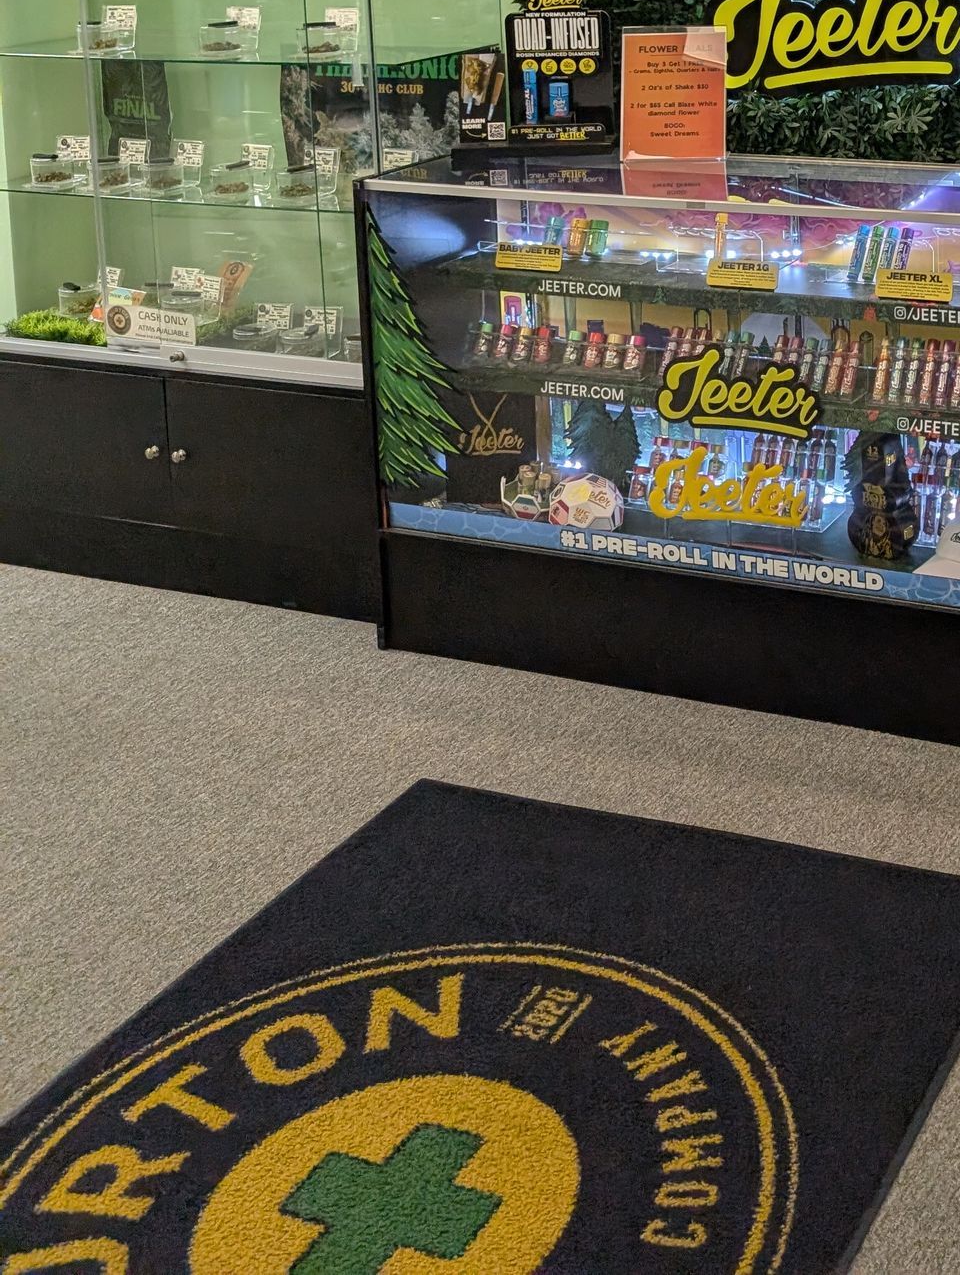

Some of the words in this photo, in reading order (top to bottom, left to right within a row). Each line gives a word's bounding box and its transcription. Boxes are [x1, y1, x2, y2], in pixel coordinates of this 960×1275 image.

[514, 17, 600, 51] QUAD-INFUSED
[397, 84, 424, 94] CLUB
[113, 99, 160, 119] FINAL
[499, 244, 524, 252] BABY
[526, 245, 560, 255] JEETER
[718, 261, 755, 271] JEETER
[887, 272, 927, 282] JEETER
[930, 274, 943, 283] XL
[538, 279, 622, 298] JEETER.COM
[138, 311, 161, 323] CASH
[163, 314, 188, 326] ONLY
[540, 381, 624, 402] JEETER.COM
[658, 349, 818, 436] Jeeter
[649, 447, 809, 526] Jeeter
[560, 530, 588, 550] #1
[593, 534, 708, 567] PRE-ROLL
[712, 549, 737, 571] IN
[741, 554, 790, 579] THE
[794, 563, 884, 591] WORLD
[600, 1019, 725, 1249] COMPANY
